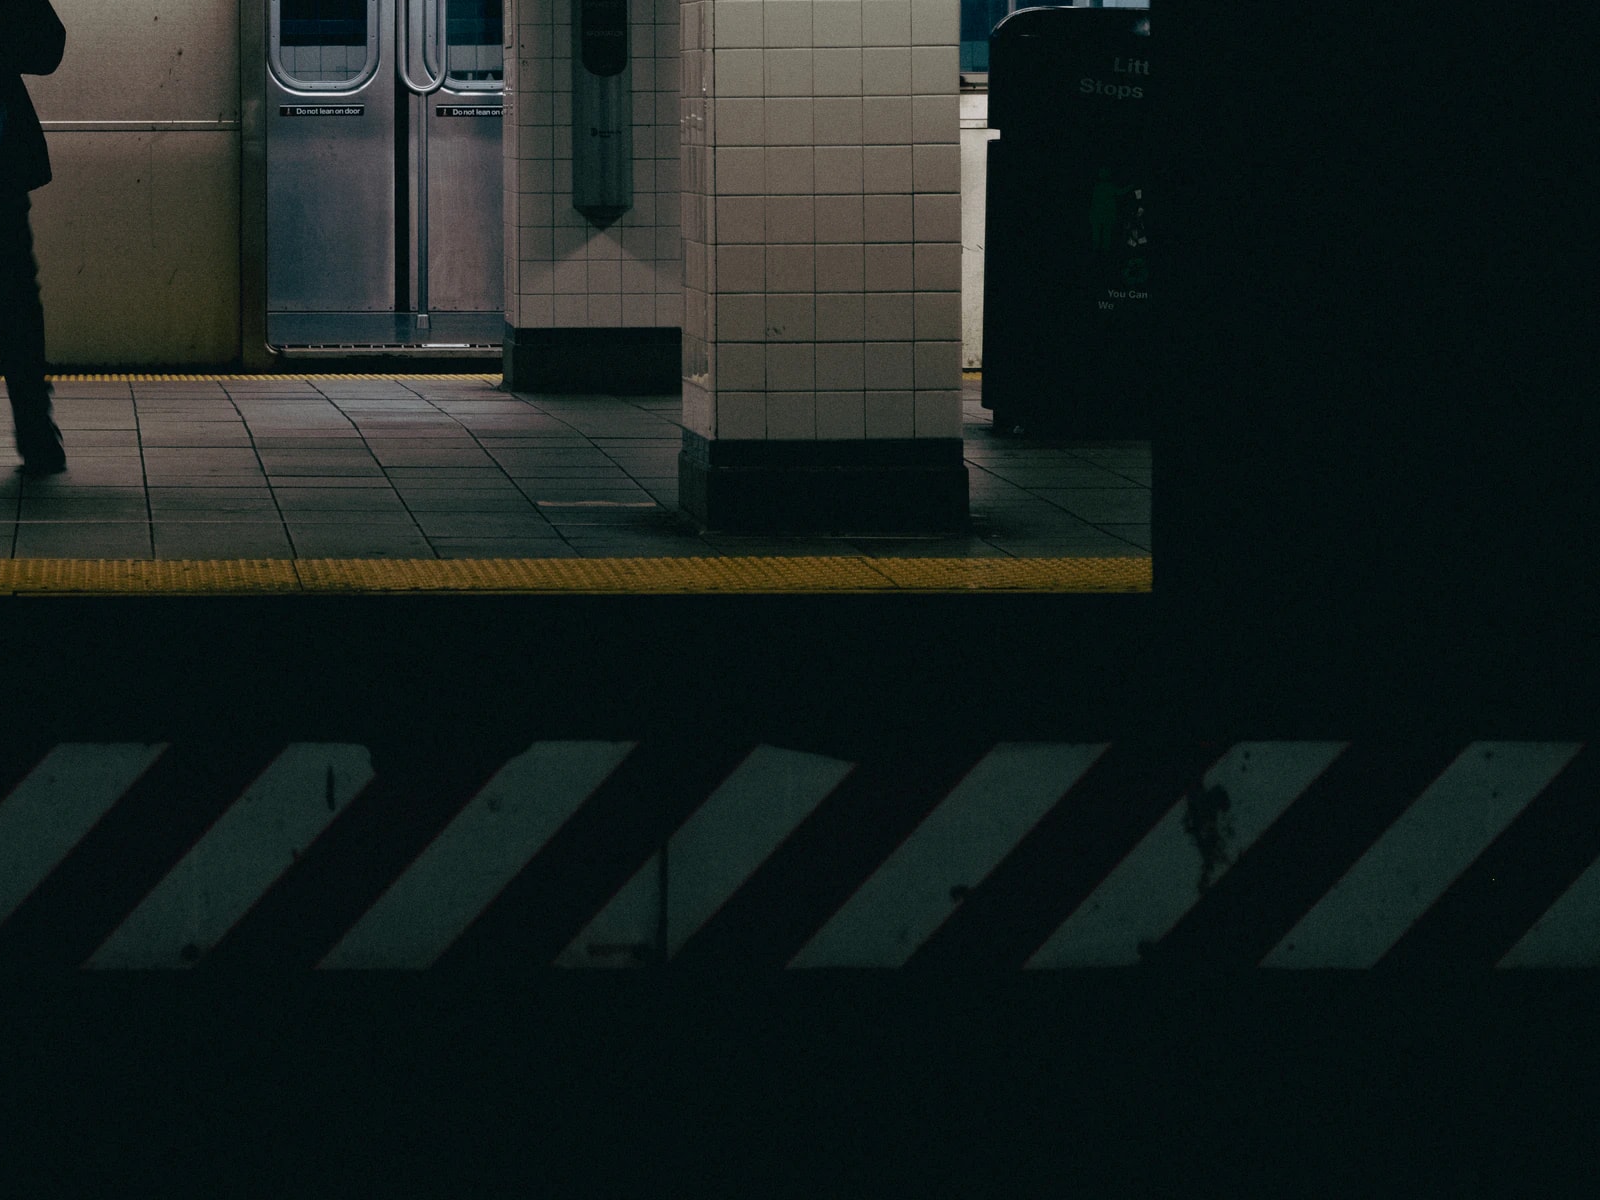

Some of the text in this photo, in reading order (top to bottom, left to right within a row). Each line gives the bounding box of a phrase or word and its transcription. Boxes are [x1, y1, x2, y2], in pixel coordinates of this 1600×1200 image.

[1080, 78, 1144, 100] Stops
[453, 108, 462, 116] Do
[463, 108, 475, 116] not
[475, 108, 490, 116] lean
[1108, 289, 1148, 299] You Can
[1098, 301, 1114, 310] We
